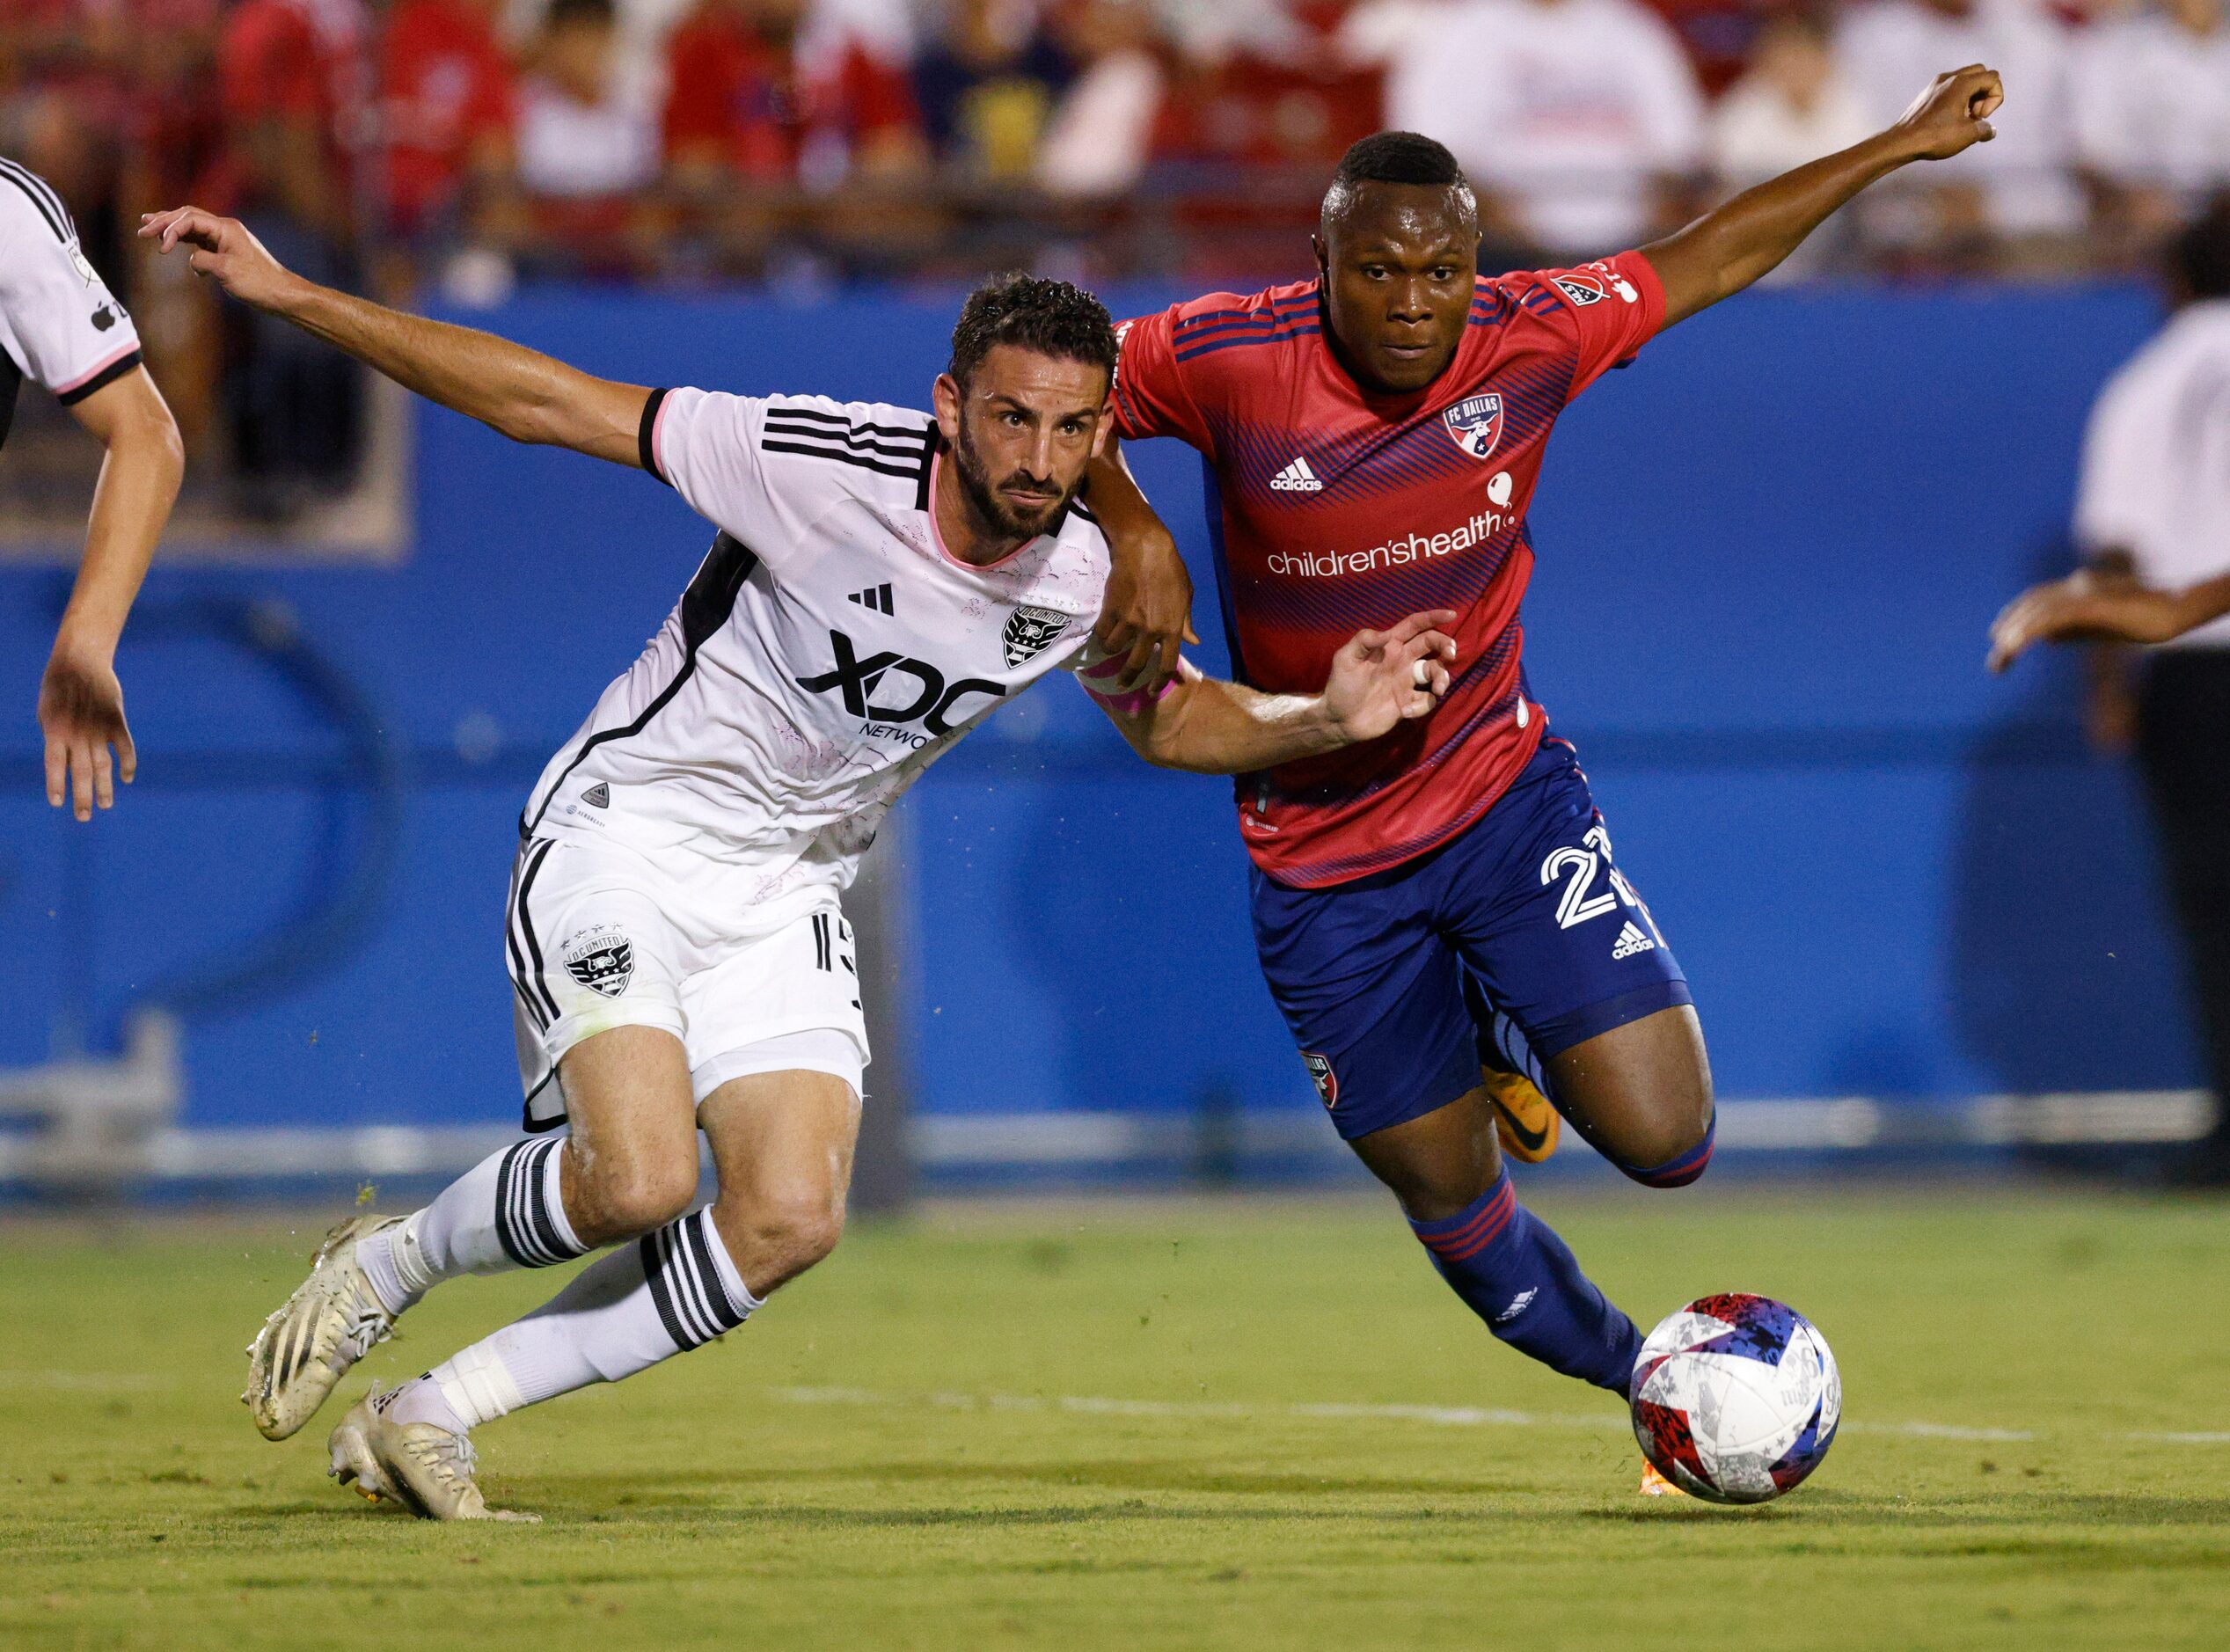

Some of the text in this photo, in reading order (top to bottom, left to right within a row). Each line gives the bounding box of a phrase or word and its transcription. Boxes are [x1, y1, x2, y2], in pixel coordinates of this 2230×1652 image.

[1448, 398, 1498, 424] FC DALLAS
[1269, 479, 1323, 491] adidas
[795, 629, 1006, 736] XDC
[859, 722, 929, 749] NETWO
[1612, 939, 1655, 960] adidas
